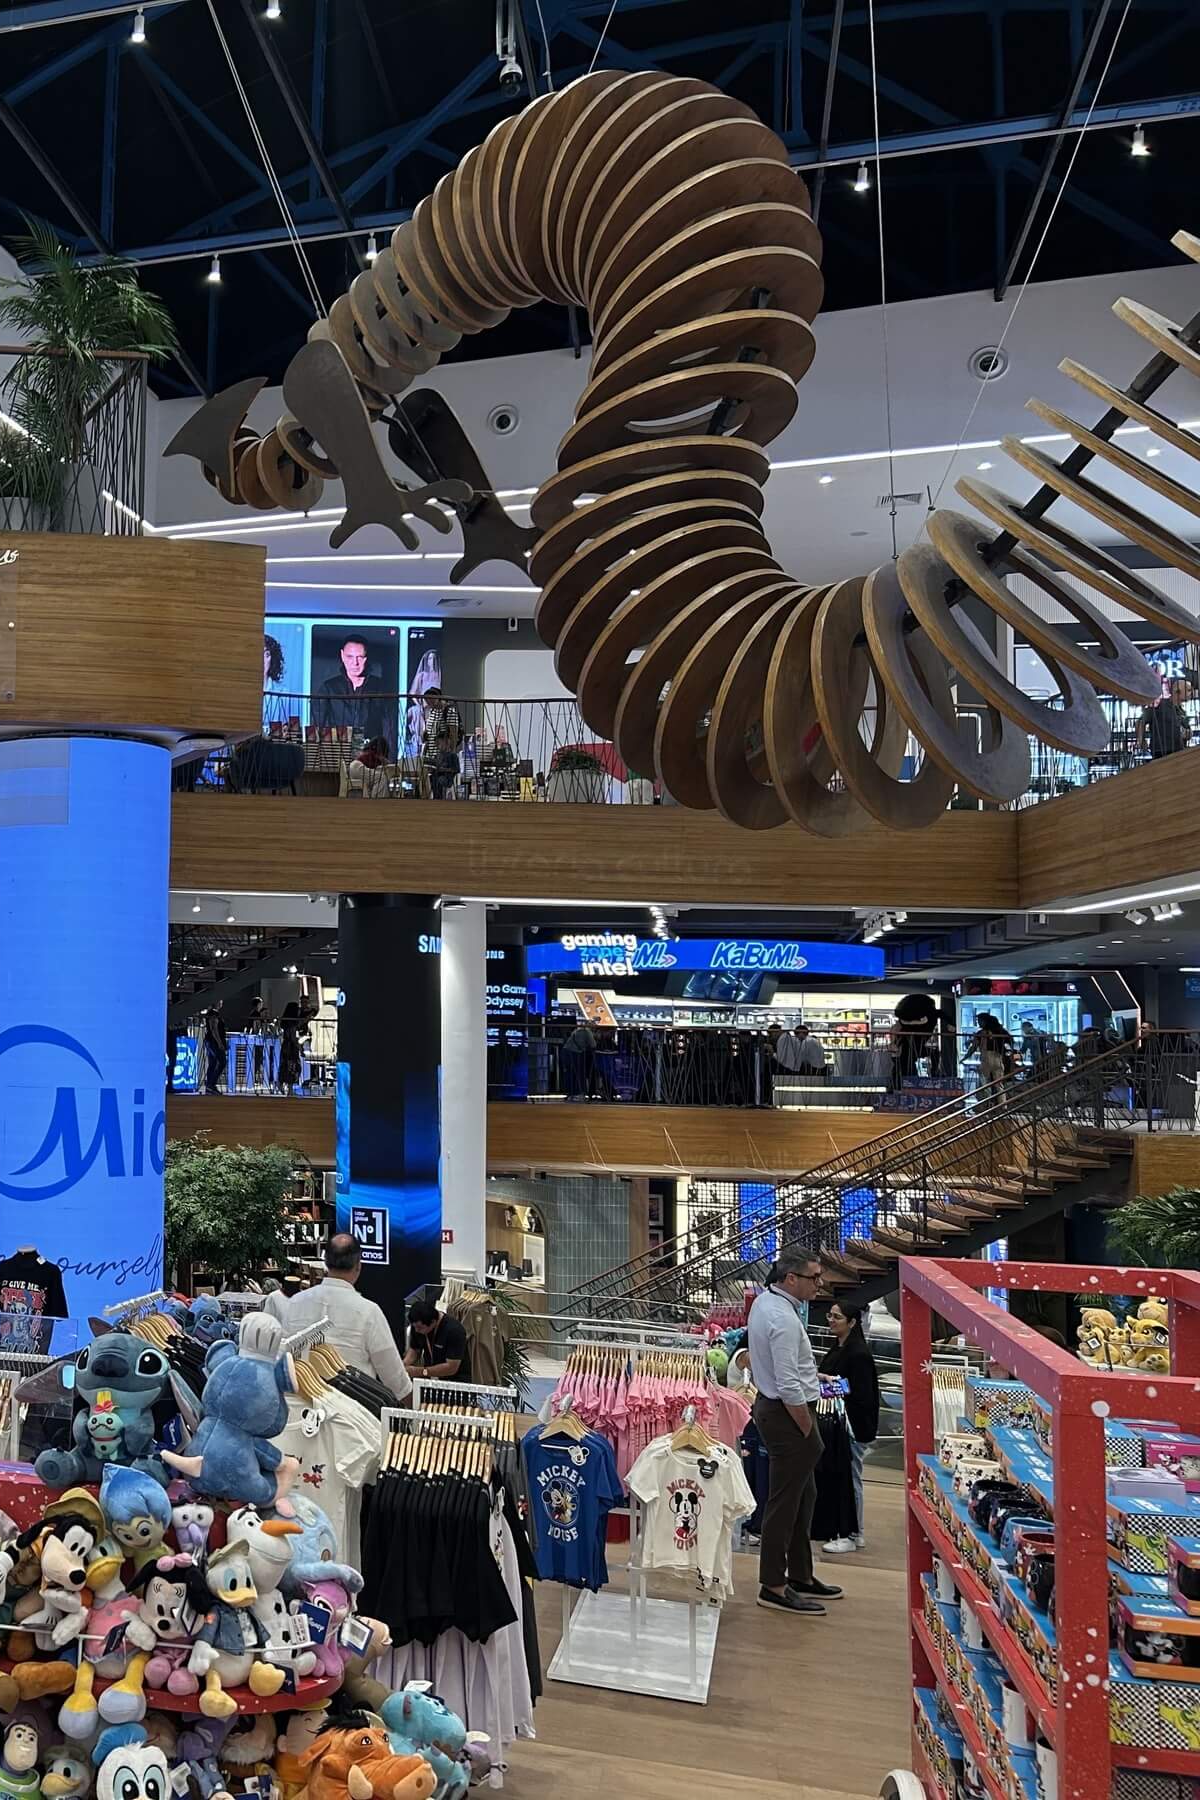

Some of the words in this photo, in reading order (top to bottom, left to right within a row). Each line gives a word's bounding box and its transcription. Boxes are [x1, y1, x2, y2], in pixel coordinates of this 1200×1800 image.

[561, 931, 638, 951] gaming
[580, 947, 624, 957] zone
[502, 984, 527, 995] Game
[372, 1211, 383, 1244] 1
[361, 1251, 383, 1260] anos
[9, 1280, 26, 1289] GIVE
[536, 1465, 586, 1487] MICKEY
